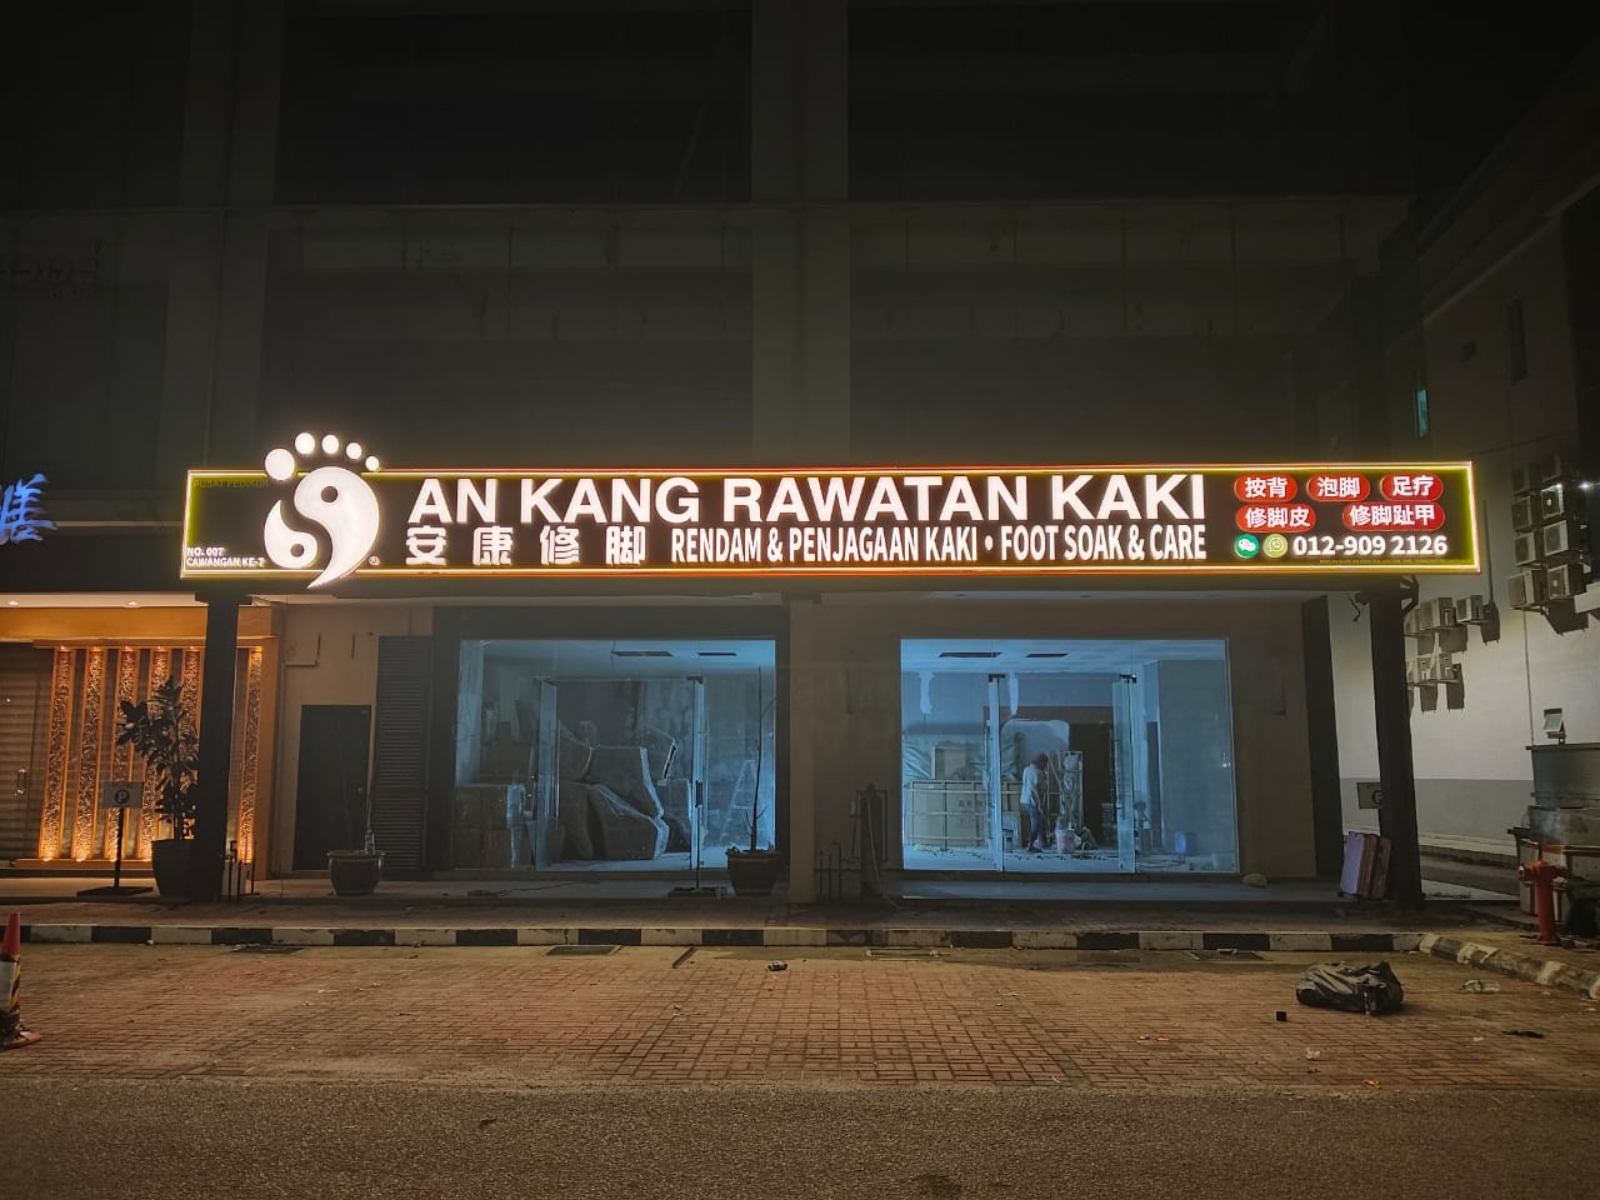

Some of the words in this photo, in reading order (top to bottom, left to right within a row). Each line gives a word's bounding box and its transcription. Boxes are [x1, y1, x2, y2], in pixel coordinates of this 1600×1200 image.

[1244, 477, 1288, 498] 按背
[1317, 477, 1360, 498] 泡脚
[1392, 475, 1434, 496] 足疗
[408, 478, 496, 523] AN
[520, 477, 700, 524] KANG
[723, 476, 1028, 522] RAWATAN
[1051, 474, 1205, 520] KAKI
[1245, 506, 1311, 528] 修脚皮
[1349, 504, 1435, 526] 修脚趾甲
[187, 546, 206, 557] NO.
[206, 546, 226, 557] 007
[405, 525, 647, 566] 安康修脚
[671, 527, 762, 563] RENDAM
[767, 527, 784, 562] &
[789, 526, 918, 562] PENJAGAAN
[925, 526, 978, 561] KAKI
[1000, 525, 1060, 561] FOOT
[1063, 524, 1123, 561] SOAK
[1127, 524, 1146, 560] &
[1149, 524, 1208, 560] CARE
[1292, 535, 1386, 556] 012-909
[1389, 535, 1448, 556] 2126
[186, 557, 242, 568] CAWANGAN
